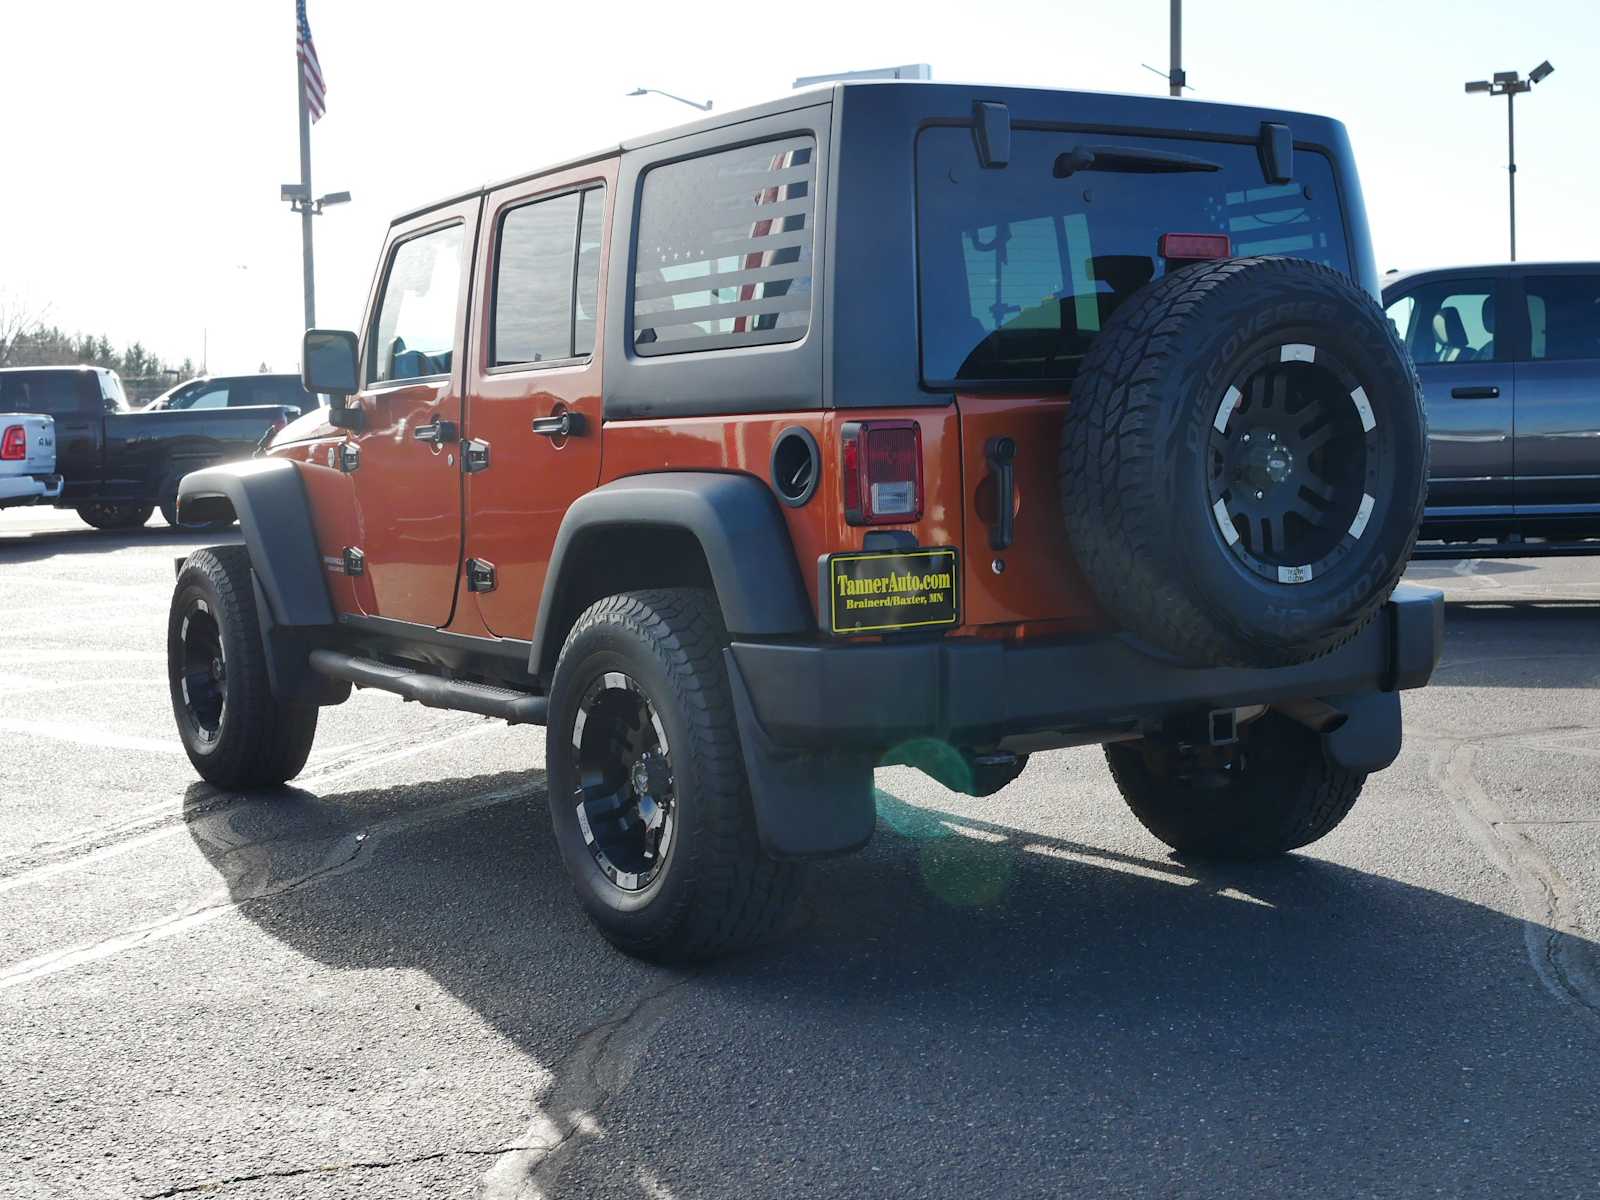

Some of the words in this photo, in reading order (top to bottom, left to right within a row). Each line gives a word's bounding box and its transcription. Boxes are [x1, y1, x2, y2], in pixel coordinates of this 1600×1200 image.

[837, 571, 951, 597] TannerAuto.com
[846, 595, 928, 610] Brainerd/Baxter,
[929, 592, 944, 603] MN
